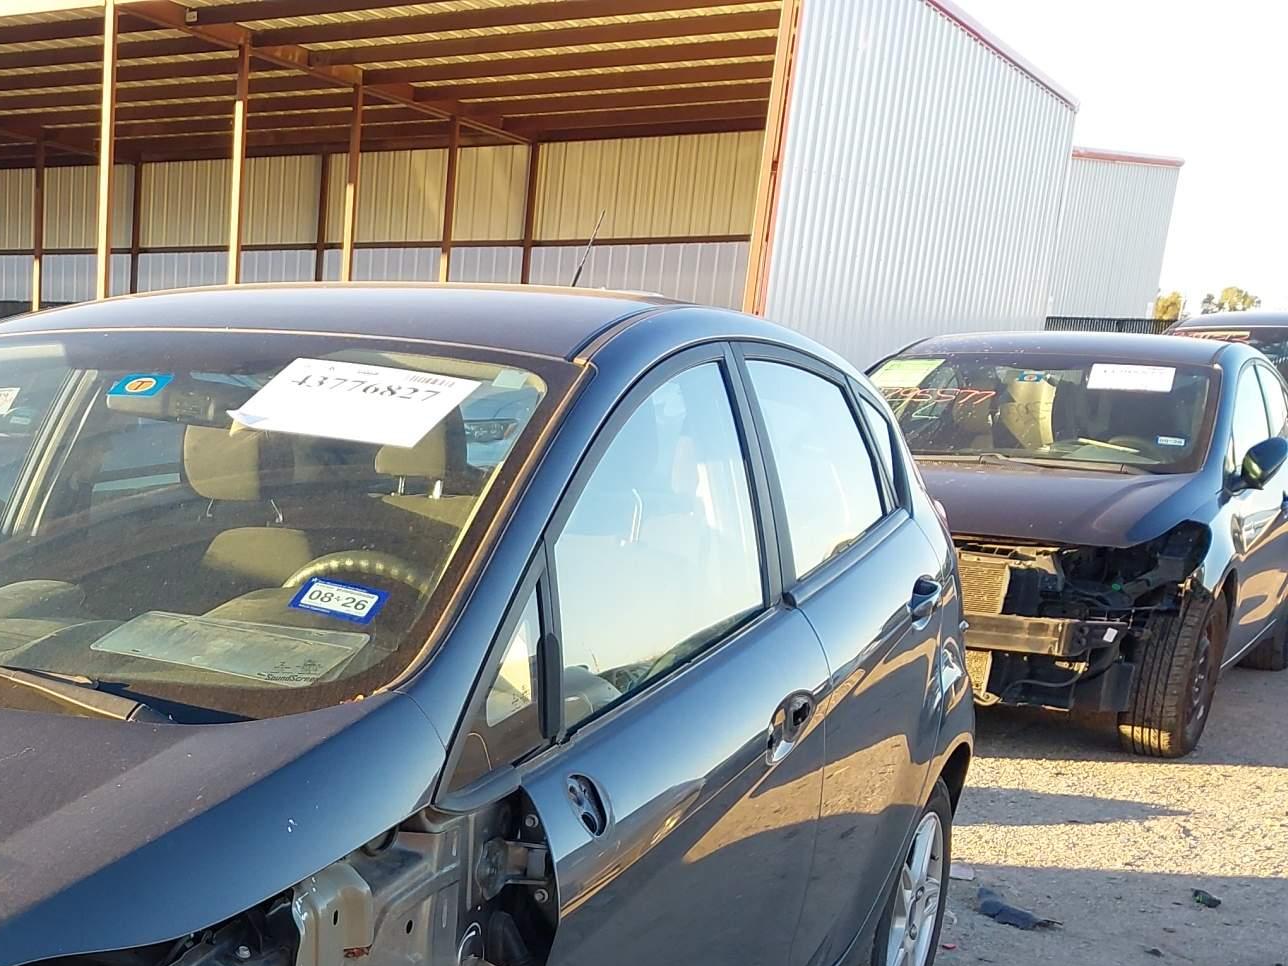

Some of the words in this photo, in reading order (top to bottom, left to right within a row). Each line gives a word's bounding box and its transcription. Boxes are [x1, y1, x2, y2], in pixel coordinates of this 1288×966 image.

[292, 374, 441, 402] 43776827
[309, 590, 335, 603] 08
[341, 597, 369, 611] 26
